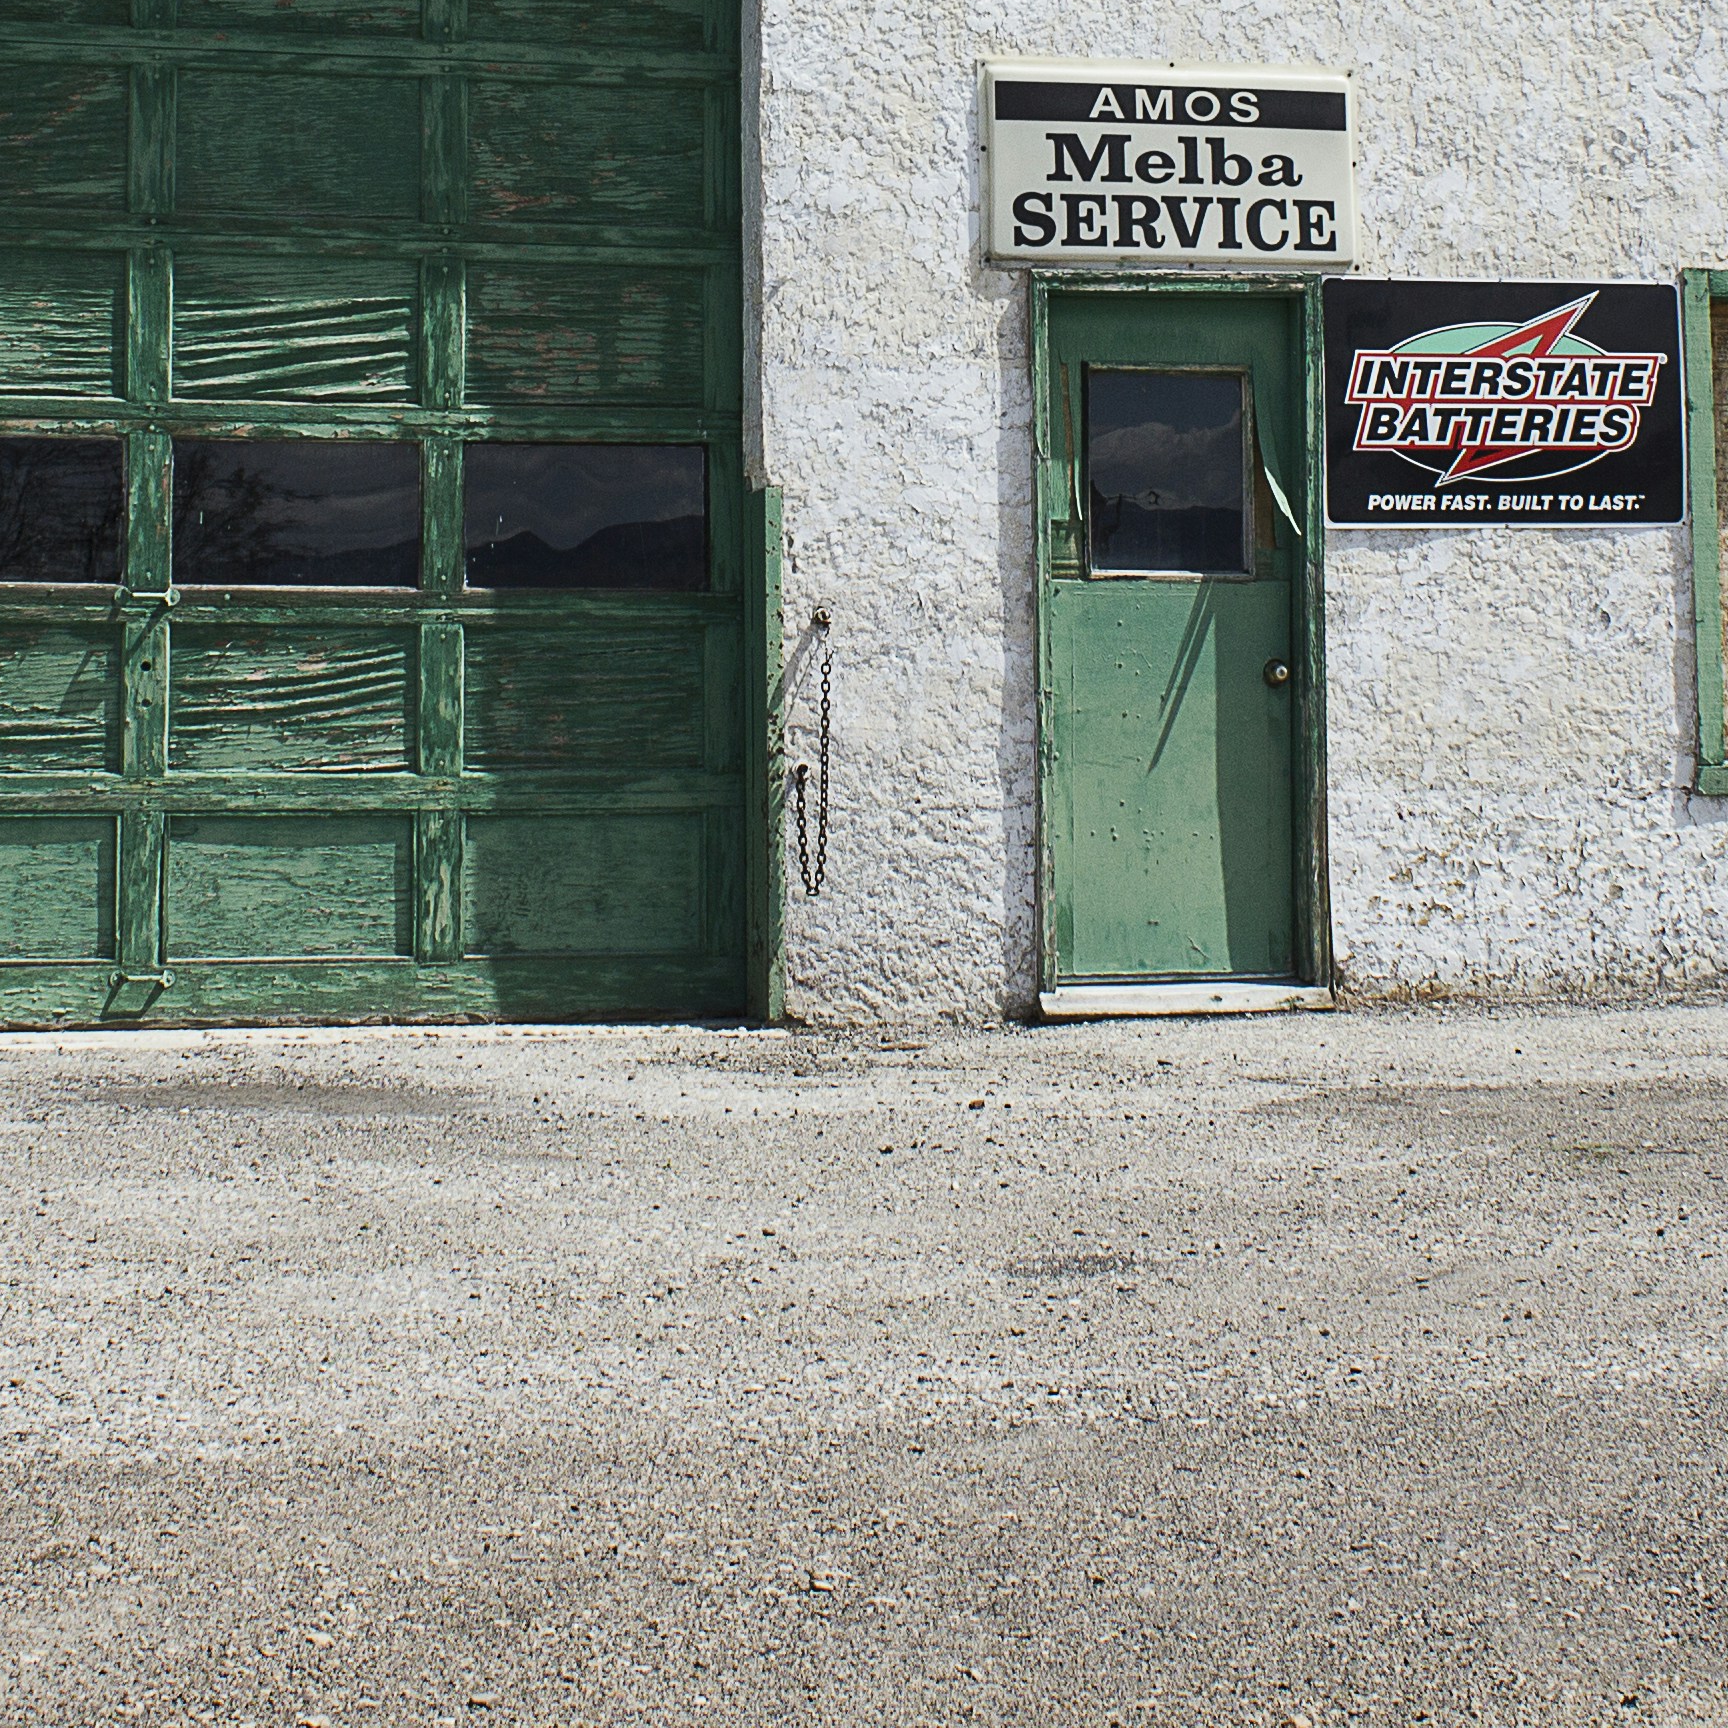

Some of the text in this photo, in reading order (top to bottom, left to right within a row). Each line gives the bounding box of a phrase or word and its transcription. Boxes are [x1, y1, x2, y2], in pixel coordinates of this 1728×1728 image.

[1088, 87, 1260, 123] AMOS
[1045, 132, 1303, 187] Melba
[1012, 191, 1337, 252] SERVICE
[1353, 357, 1654, 399] INTERSTATE
[1363, 404, 1632, 445] BATTERIES
[1367, 494, 1436, 510] POWER
[1440, 494, 1493, 511] FAST.
[1497, 494, 1554, 511] BUILT
[1558, 495, 1584, 511] TO
